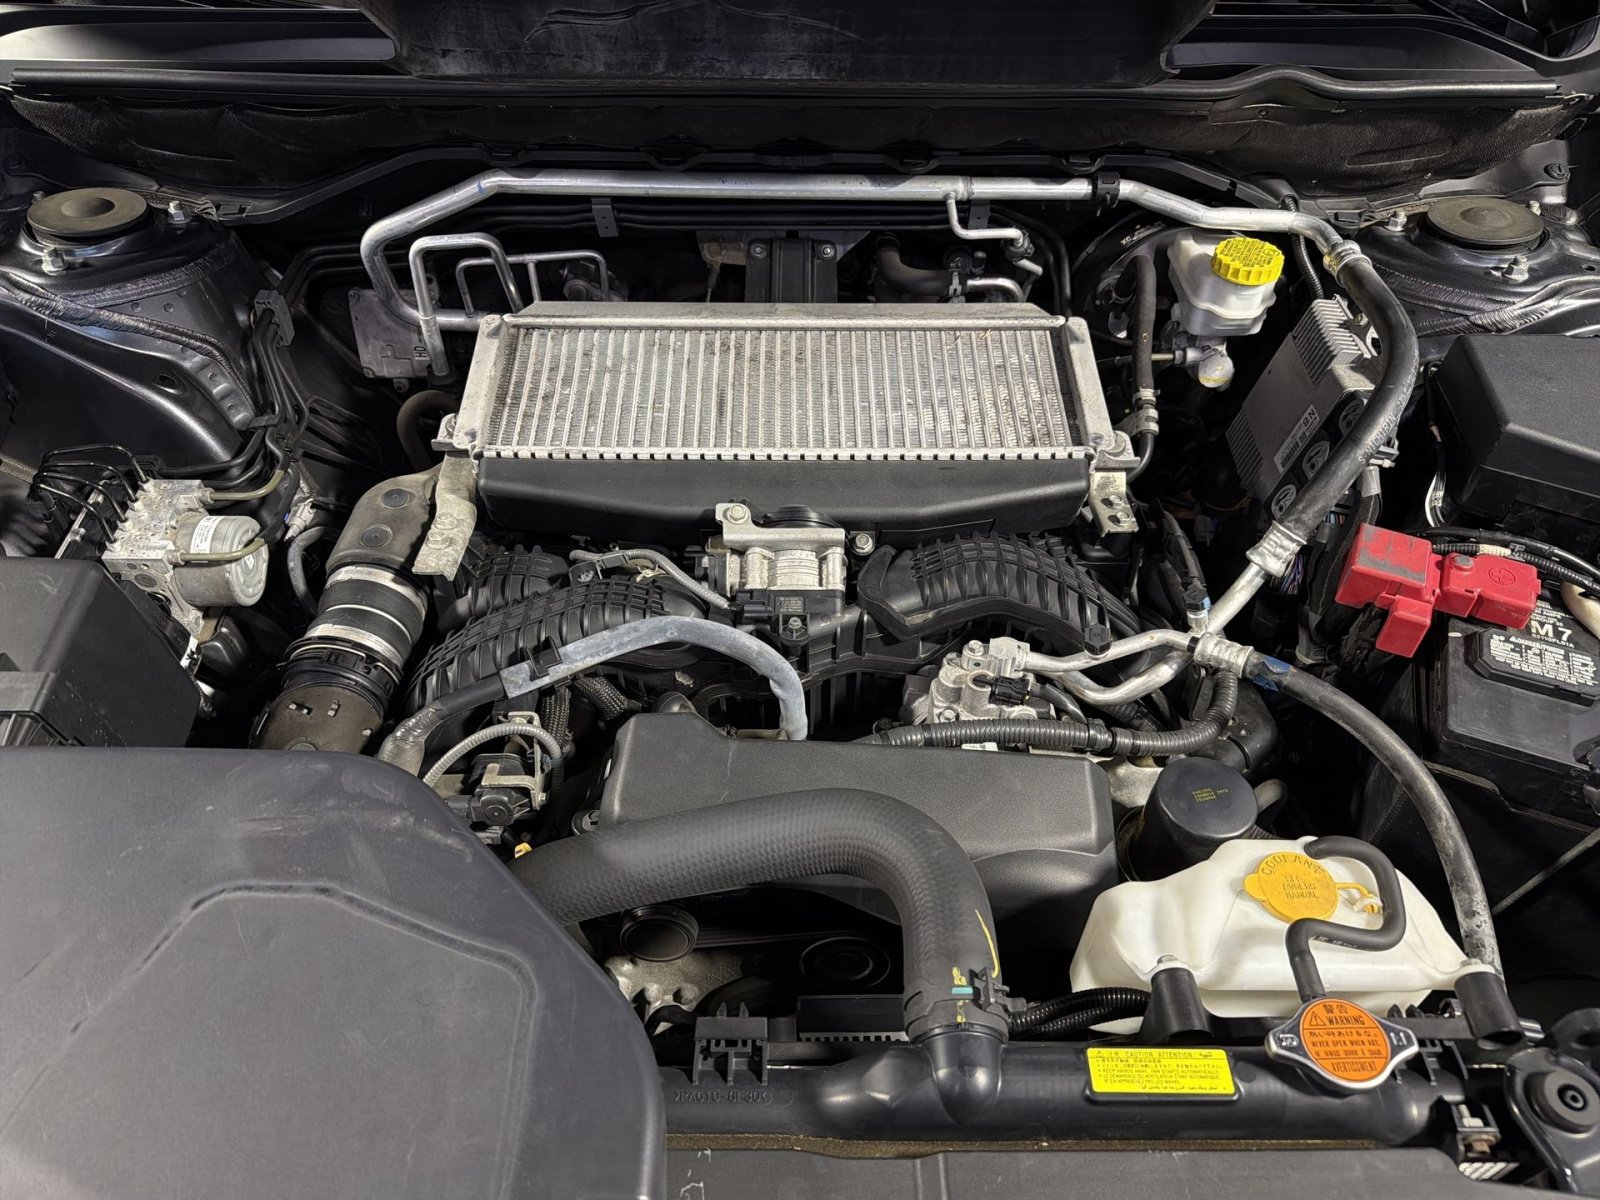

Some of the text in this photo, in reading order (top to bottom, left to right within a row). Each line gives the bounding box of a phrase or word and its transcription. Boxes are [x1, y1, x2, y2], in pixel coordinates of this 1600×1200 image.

[1327, 1015, 1366, 1026] WARNING
[1125, 1050, 1154, 1058] CAUTION
[1158, 1050, 1193, 1059] ATTENTION
